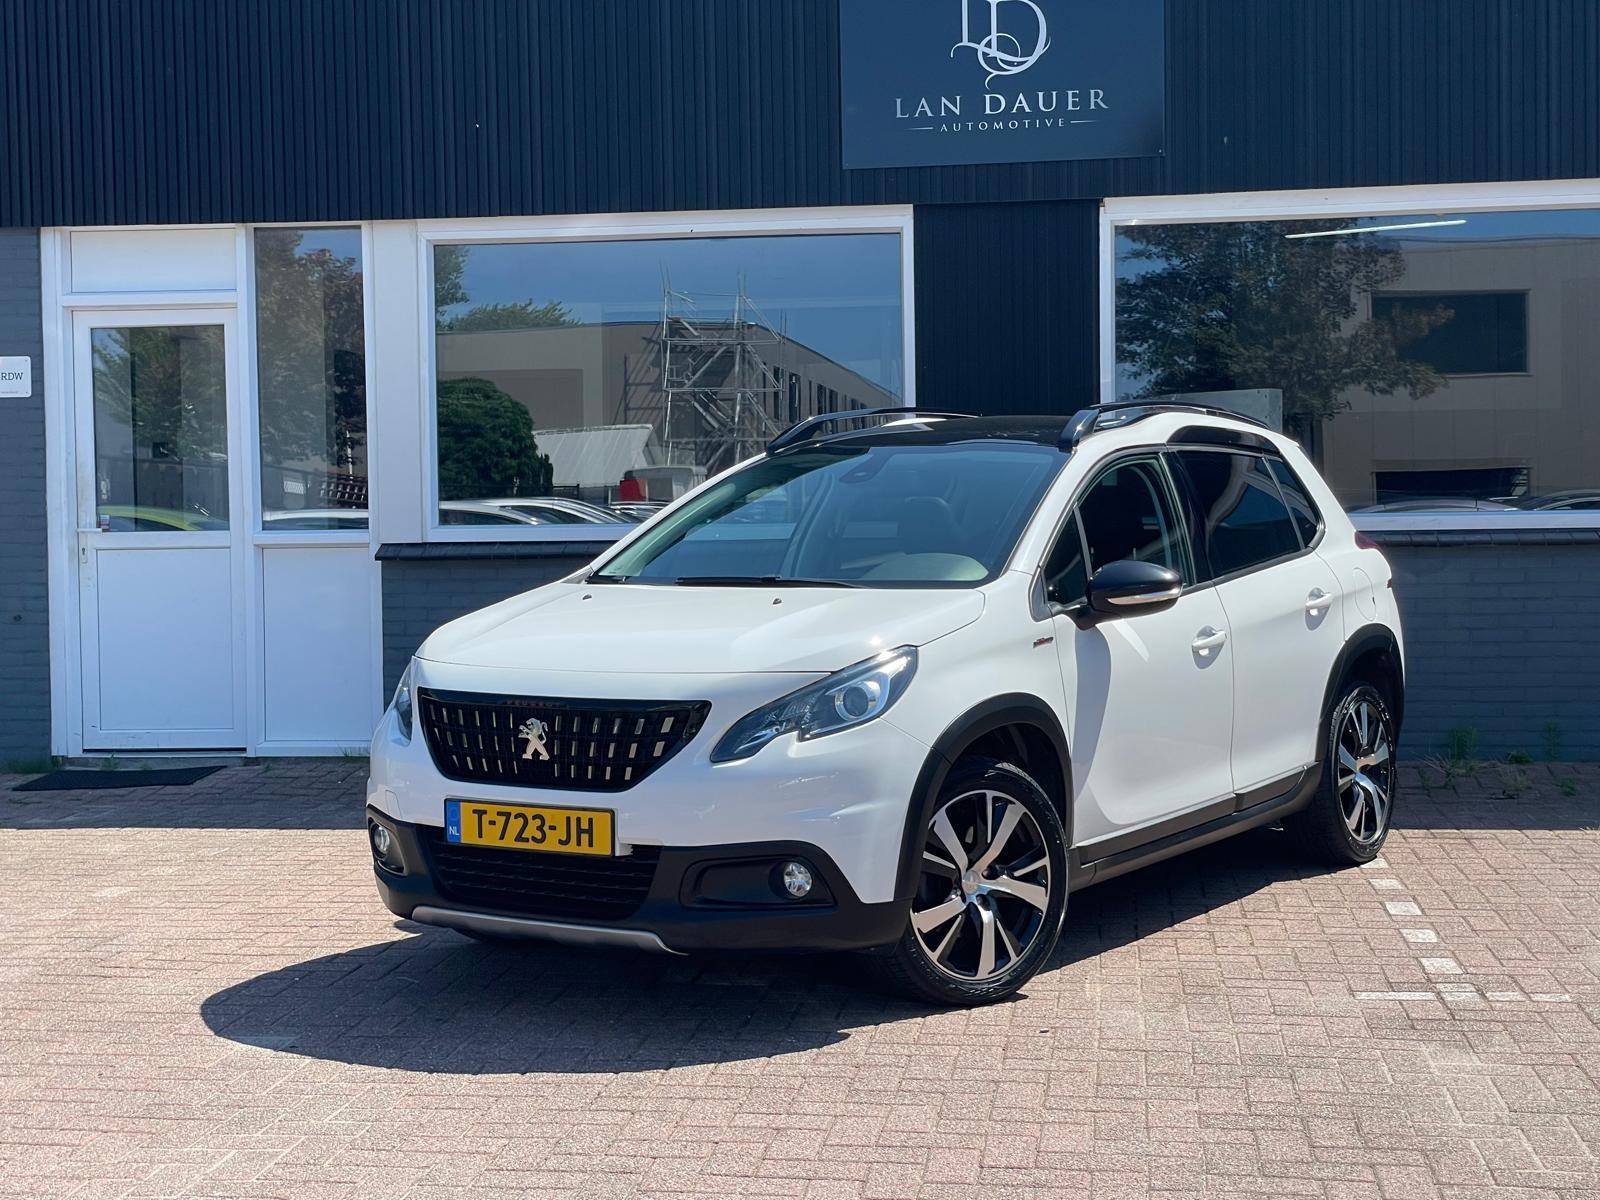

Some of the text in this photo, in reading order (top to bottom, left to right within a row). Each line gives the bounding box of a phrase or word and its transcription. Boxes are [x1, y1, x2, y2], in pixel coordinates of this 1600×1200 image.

[895, 89, 1109, 119] LAN DAUER
[940, 118, 1065, 132] AUTOMOTIVE
[1, 372, 24, 381] RDW
[449, 825, 460, 836] NL
[471, 808, 594, 848] T-723-JH
